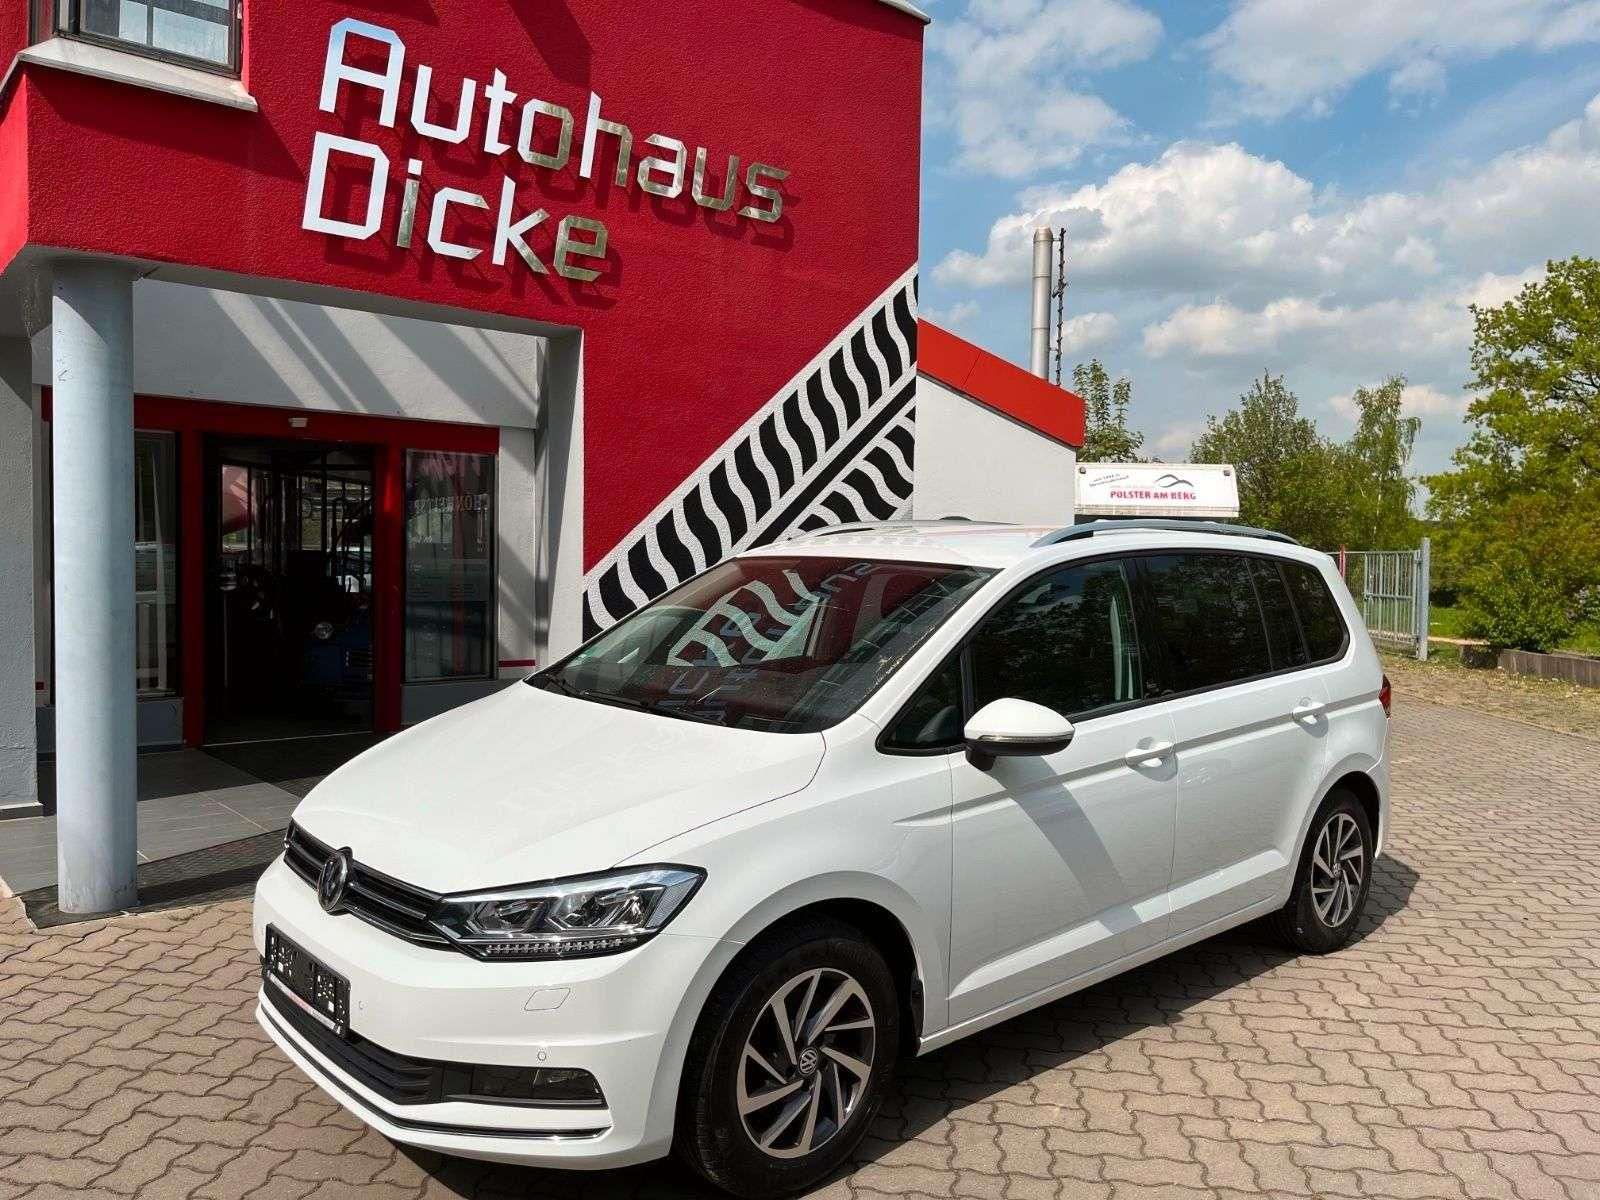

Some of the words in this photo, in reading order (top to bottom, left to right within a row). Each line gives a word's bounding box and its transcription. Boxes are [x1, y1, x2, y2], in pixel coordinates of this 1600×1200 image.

[319, 18, 790, 223] Autohaus
[302, 131, 608, 282] Dicke
[1110, 490, 1151, 500] POLSTER
[1153, 491, 1168, 500] AM
[1170, 491, 1197, 500] BERG
